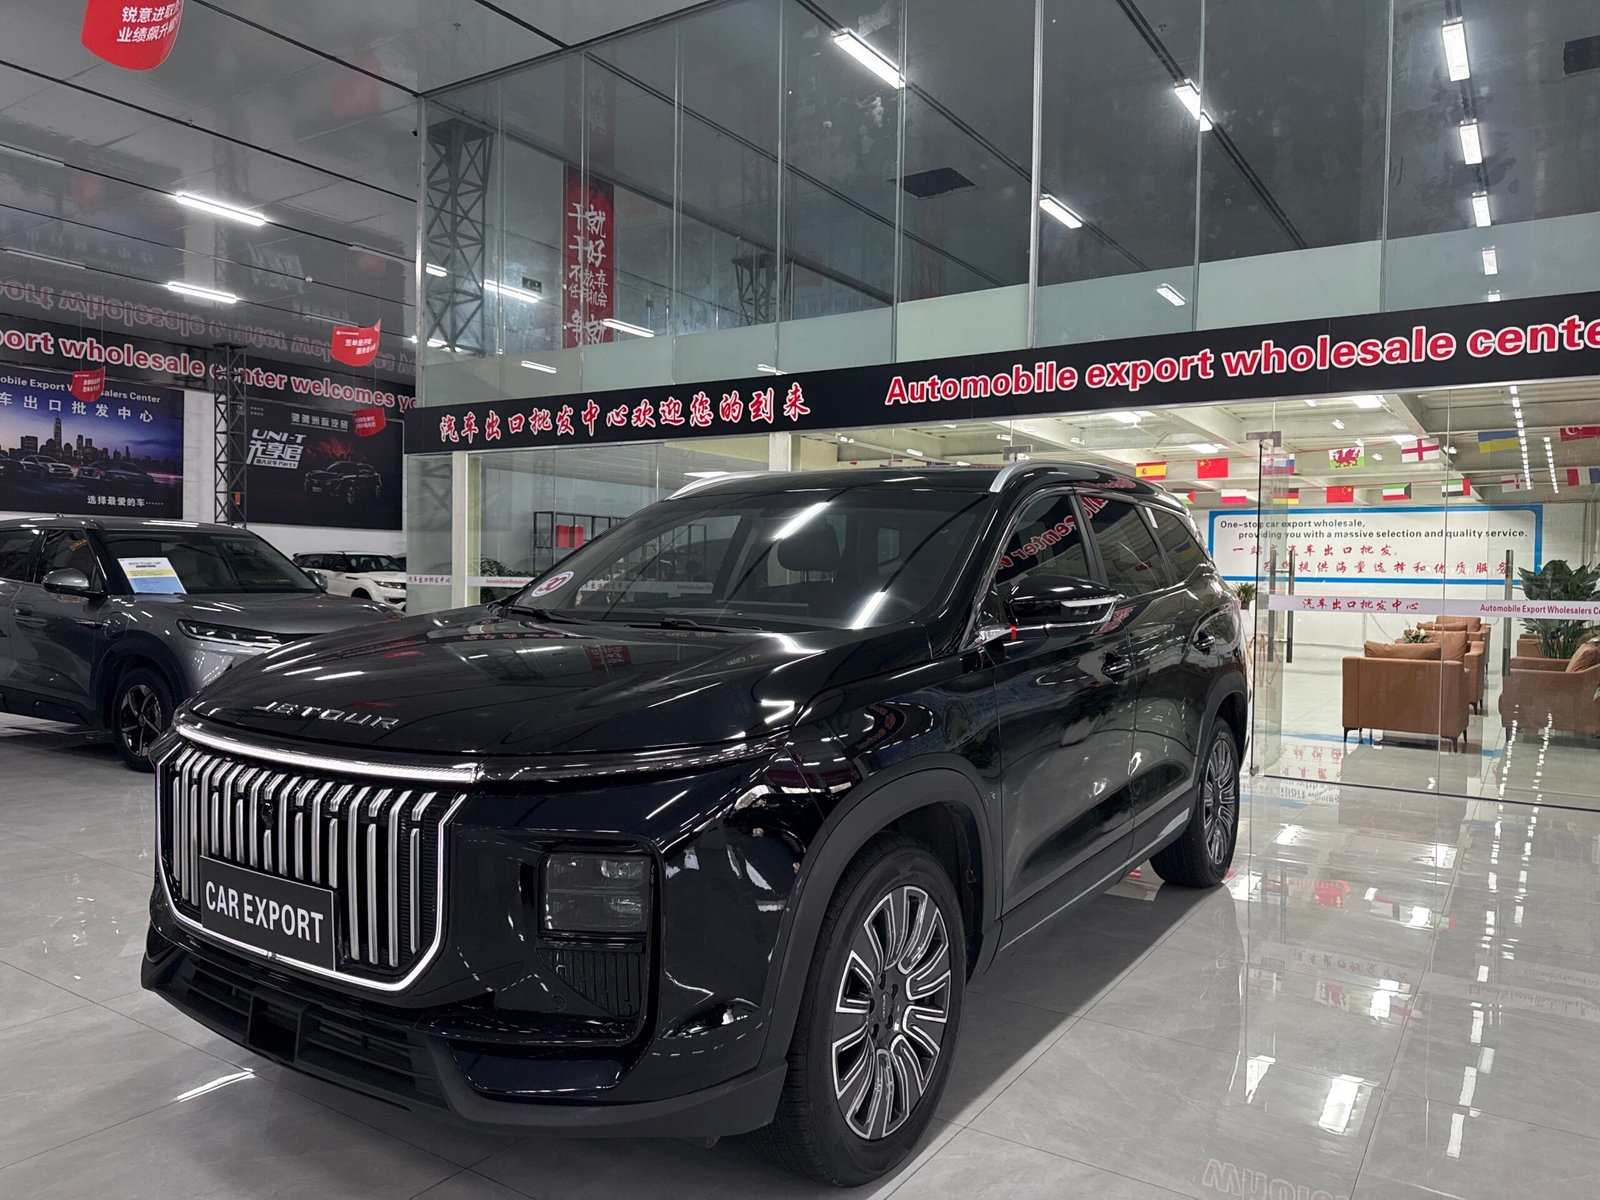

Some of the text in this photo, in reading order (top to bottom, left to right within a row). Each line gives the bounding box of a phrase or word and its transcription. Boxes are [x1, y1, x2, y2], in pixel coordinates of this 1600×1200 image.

[0, 330, 54, 354] ort
[59, 337, 206, 377] wholesale
[290, 377, 396, 408] welcomes
[885, 360, 1078, 405] Automobile
[1085, 348, 1214, 392] export
[1221, 325, 1457, 378] wholesale
[29, 379, 65, 392] Export
[130, 392, 161, 403] Center
[440, 381, 811, 444] 汽车出口批发中心欢迎您的到来
[252, 429, 307, 443] UNI-T
[1281, 520, 1311, 529] export
[1285, 531, 1301, 539] you
[1303, 530, 1325, 538] with
[1334, 530, 1374, 538] massive
[1376, 529, 1422, 538] selection
[1424, 529, 1444, 537] and
[1445, 529, 1483, 539] quality
[1486, 528, 1528, 537] service.
[1302, 597, 1419, 613] 汽车出口批发中心
[1480, 604, 1520, 613] Automobile
[1522, 605, 1546, 614] Export
[1547, 605, 1592, 615] Wholesalers
[253, 701, 399, 730] JETOUR
[205, 880, 324, 944] CAR EXPORT
